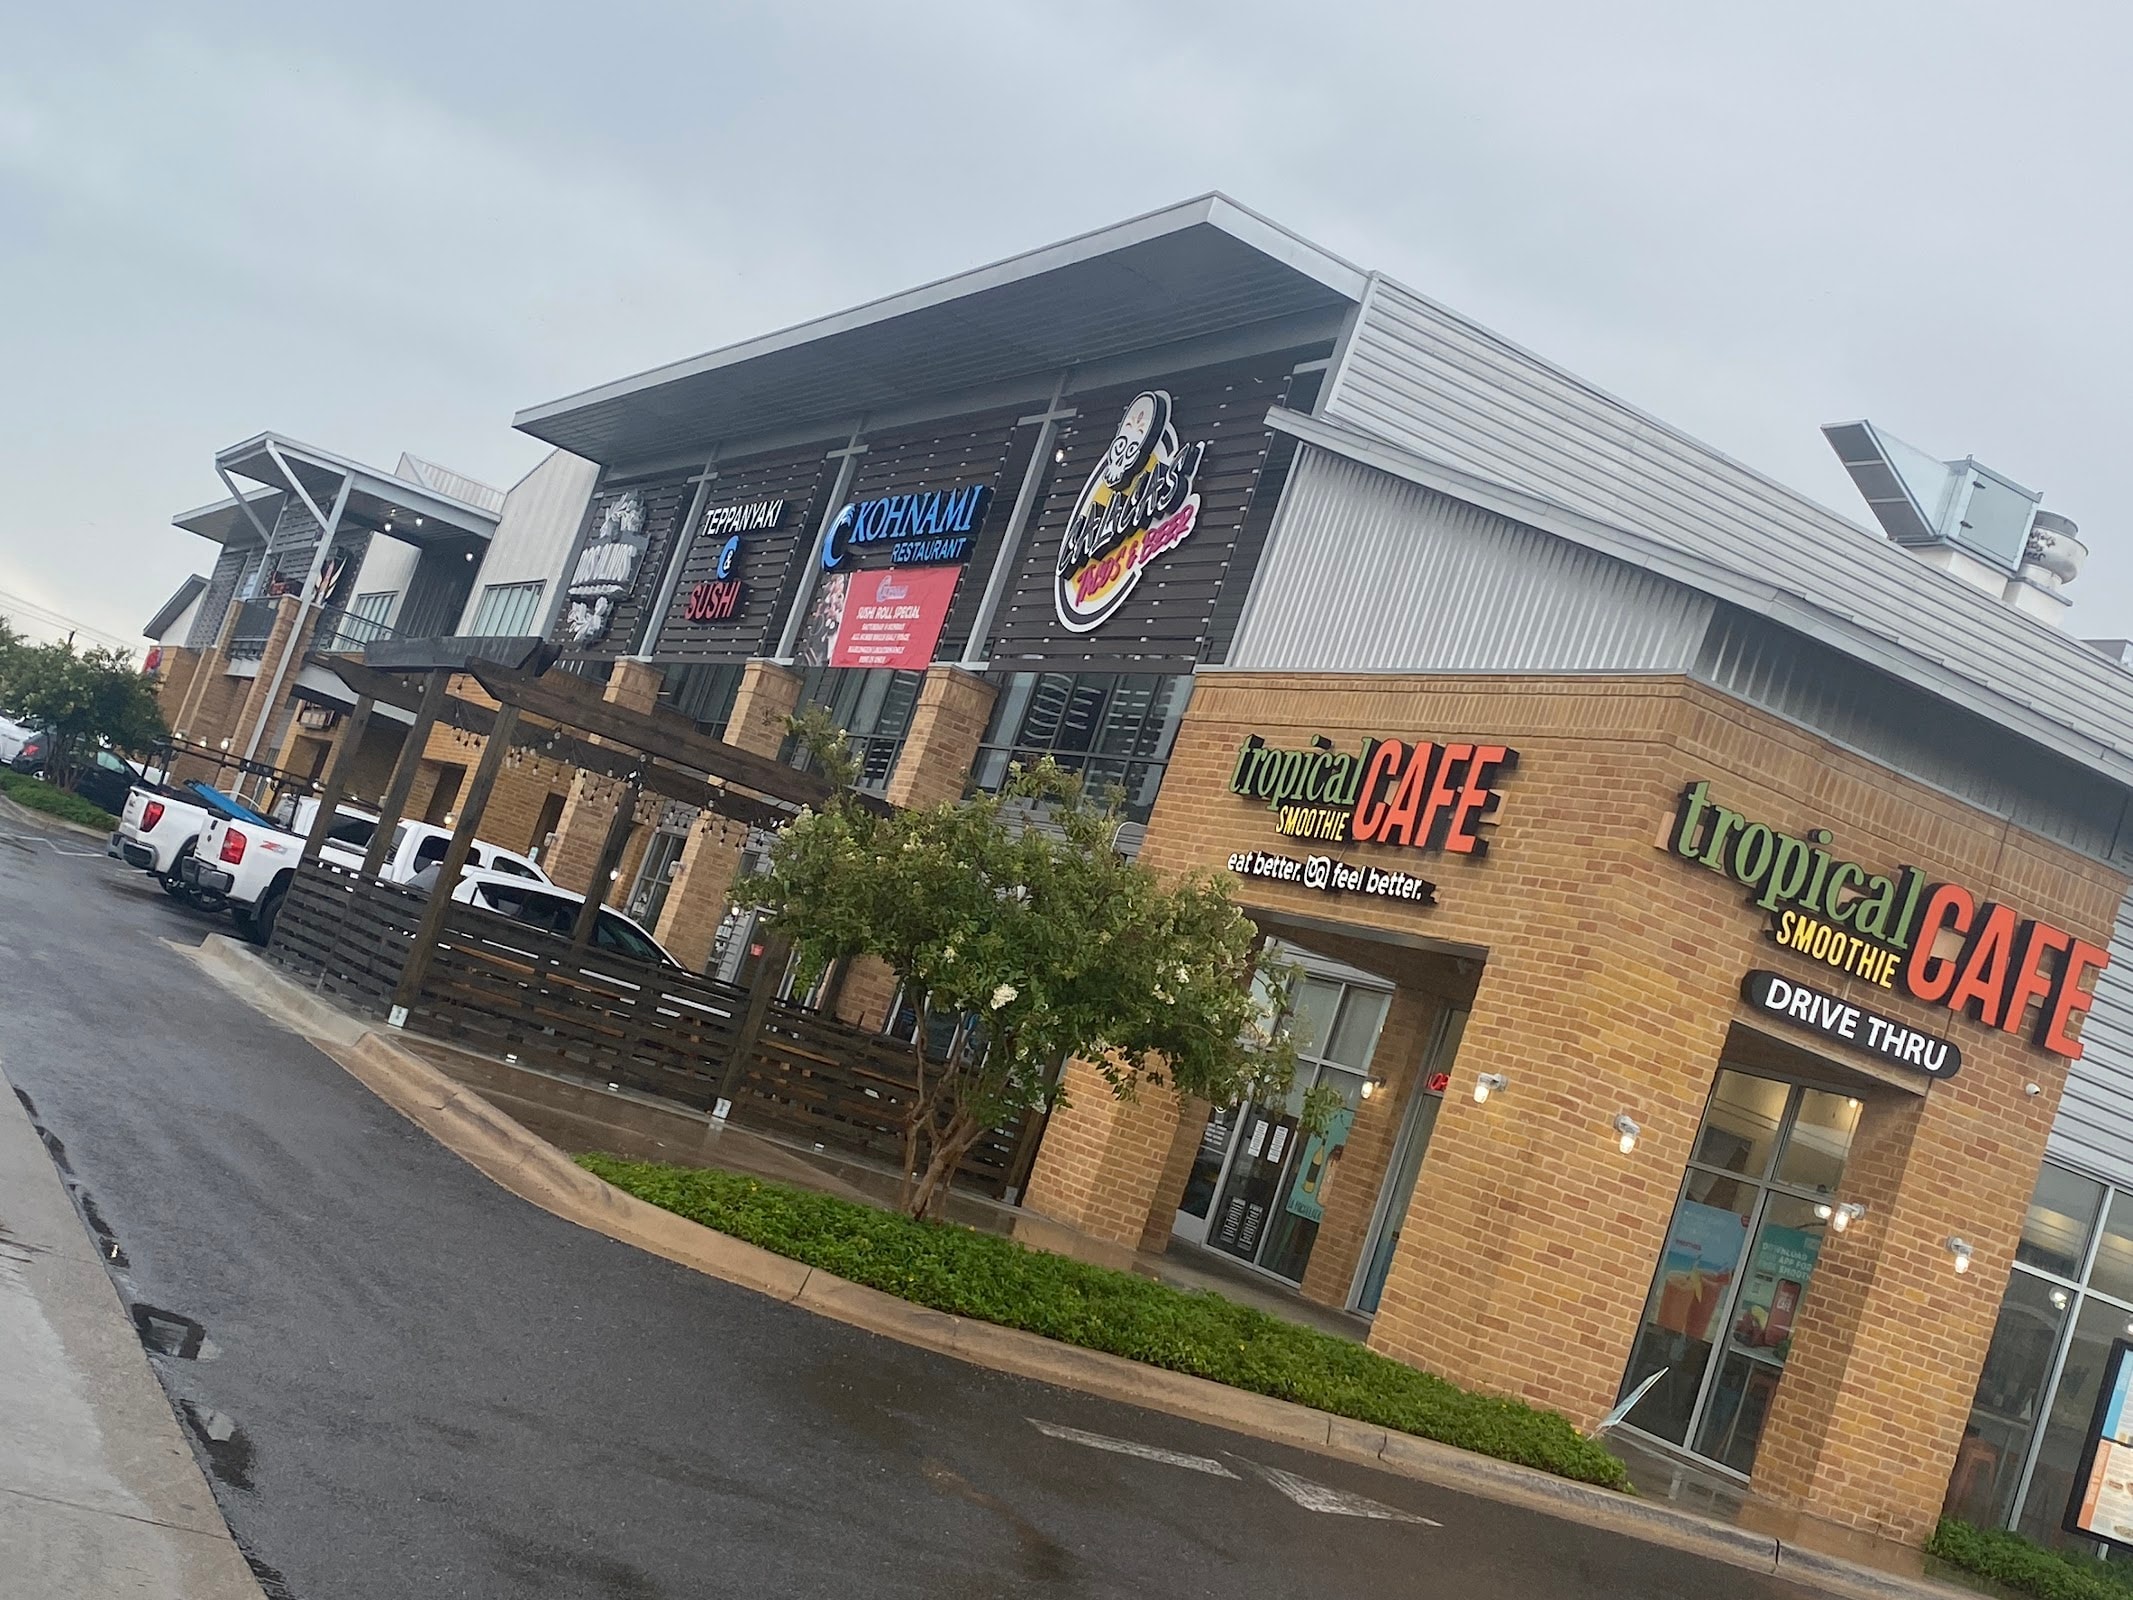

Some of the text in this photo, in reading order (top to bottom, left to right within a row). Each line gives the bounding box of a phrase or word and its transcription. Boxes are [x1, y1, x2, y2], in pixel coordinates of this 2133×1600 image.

[701, 499, 785, 536] TEPPANYAKI
[850, 485, 984, 543] KOHNAMI
[890, 537, 968, 563] RESTAURANT
[1138, 504, 1195, 565] BEER
[685, 580, 741, 620] SUSHI
[856, 605, 920, 619] SUSHI ROLL SPECIAL
[1228, 733, 1508, 853] tropical CAFE
[1275, 805, 1351, 842] SMOOTHIE
[1227, 851, 1301, 881] eat better.
[1331, 864, 1422, 900] feel better.
[1677, 780, 2111, 1060] tropical CAFE
[1776, 910, 1902, 990] SMOOTHIE
[1764, 978, 1949, 1073] DRIVE THRU
[1778, 1256, 1795, 1269] APP
[1795, 1261, 1813, 1273] FOR
